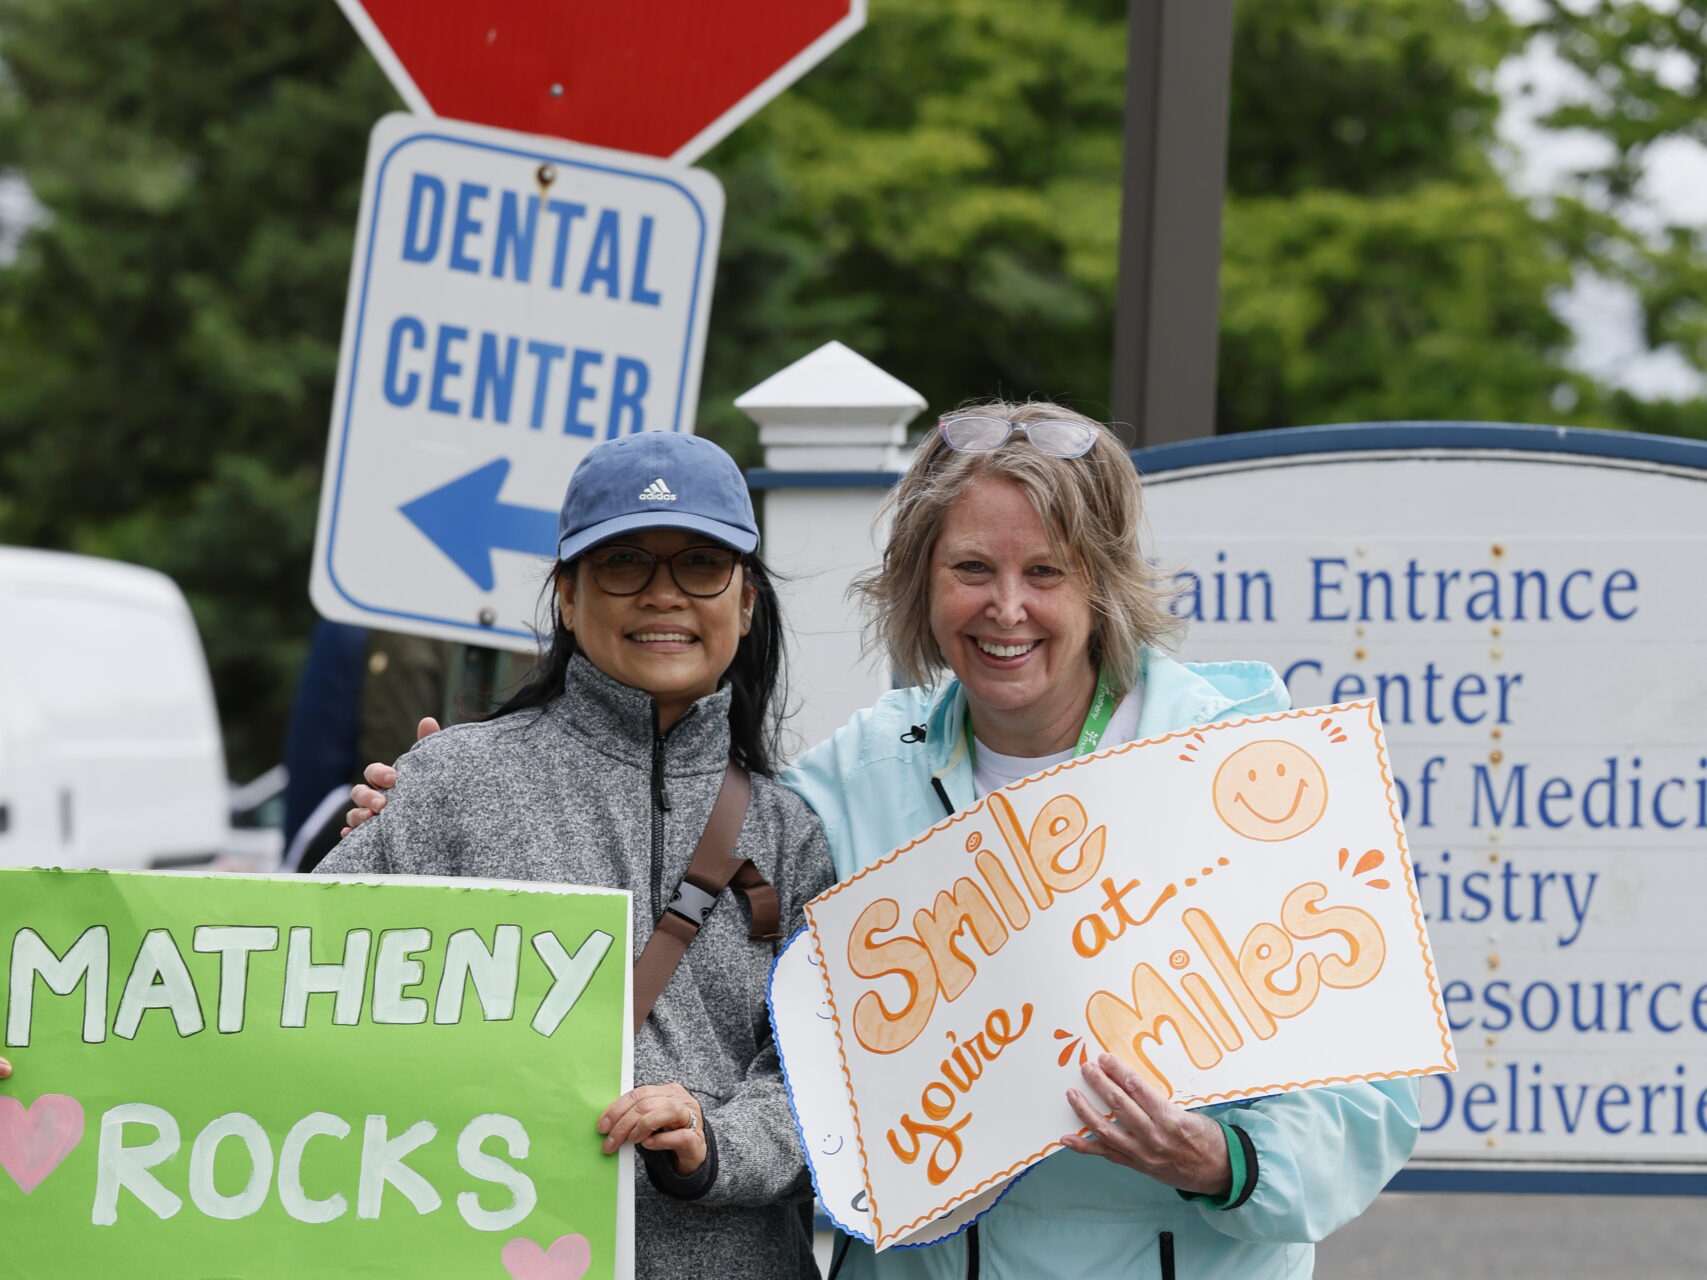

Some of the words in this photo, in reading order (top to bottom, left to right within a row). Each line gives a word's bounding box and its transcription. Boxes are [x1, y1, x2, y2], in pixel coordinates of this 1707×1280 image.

[401, 172, 662, 307] DENTAL
[382, 315, 650, 441] CENTER
[638, 491, 677, 501] adidas
[1147, 549, 1276, 622] ain
[1307, 556, 1640, 623] Entrance
[5, 924, 615, 1048] MATHENY
[847, 792, 1107, 1055] Smile
[1085, 881, 1387, 1099] Miles
[886, 1002, 1034, 1186] you're
[91, 1102, 538, 1232] ROCKS
